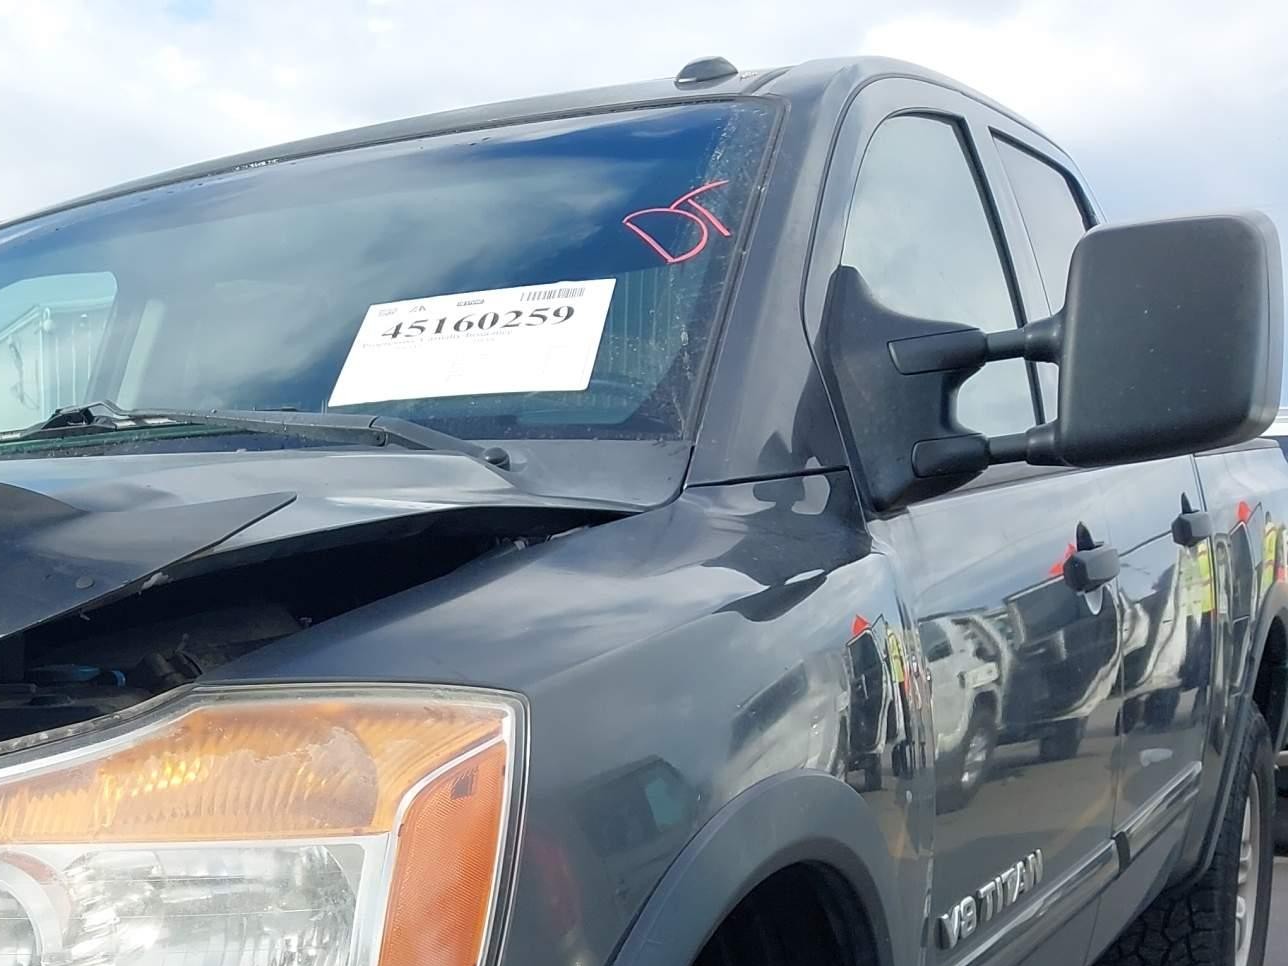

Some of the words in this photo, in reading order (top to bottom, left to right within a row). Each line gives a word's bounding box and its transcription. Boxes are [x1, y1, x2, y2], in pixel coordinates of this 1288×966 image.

[381, 304, 575, 340] 45160259
[935, 896, 977, 950] V8
[977, 849, 1043, 922] TITAN
